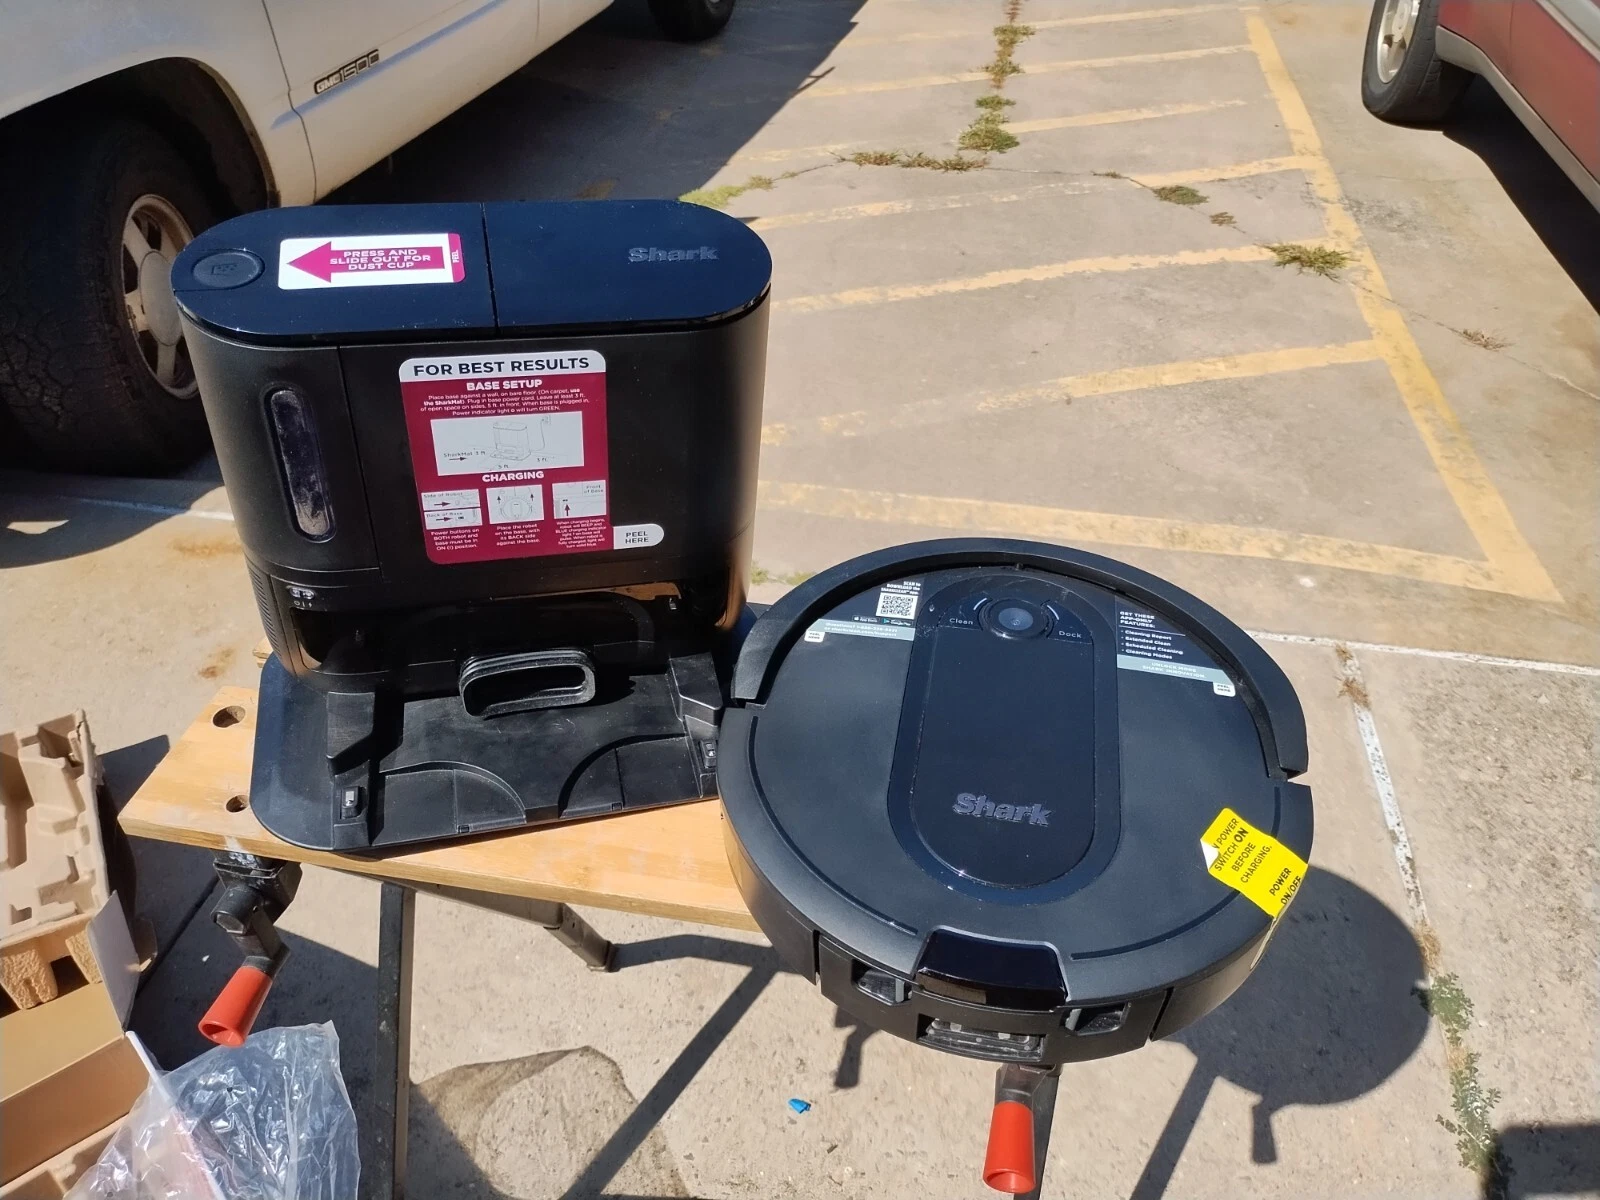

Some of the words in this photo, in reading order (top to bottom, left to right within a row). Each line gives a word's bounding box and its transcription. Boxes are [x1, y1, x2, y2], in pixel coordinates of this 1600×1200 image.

[315, 73, 341, 93] GMC
[340, 50, 379, 82] 1500
[330, 257, 372, 265] SLIDE
[628, 246, 720, 262] Shark
[413, 364, 452, 376] FOR
[458, 361, 504, 374] BEST
[511, 357, 589, 372] RESULTS
[466, 381, 500, 391] BASE
[502, 379, 543, 390] SETUP
[482, 471, 544, 482] CHARGING
[1058, 630, 1082, 638] Dock
[1125, 630, 1150, 638] Cleaning
[1125, 642, 1156, 650] Scheduled
[1157, 647, 1184, 655] Cleaning
[1125, 648, 1152, 657] Cleaning
[952, 792, 1052, 827] Shark
[1216, 818, 1239, 846] POWER
[1214, 842, 1239, 872] SWITCH
[1234, 827, 1249, 843] ON
[1232, 842, 1256, 872] BEFORE
[1240, 845, 1272, 883] CHARGING.
[1269, 867, 1292, 896] POWER
[1280, 875, 1302, 906] ON/OFF
